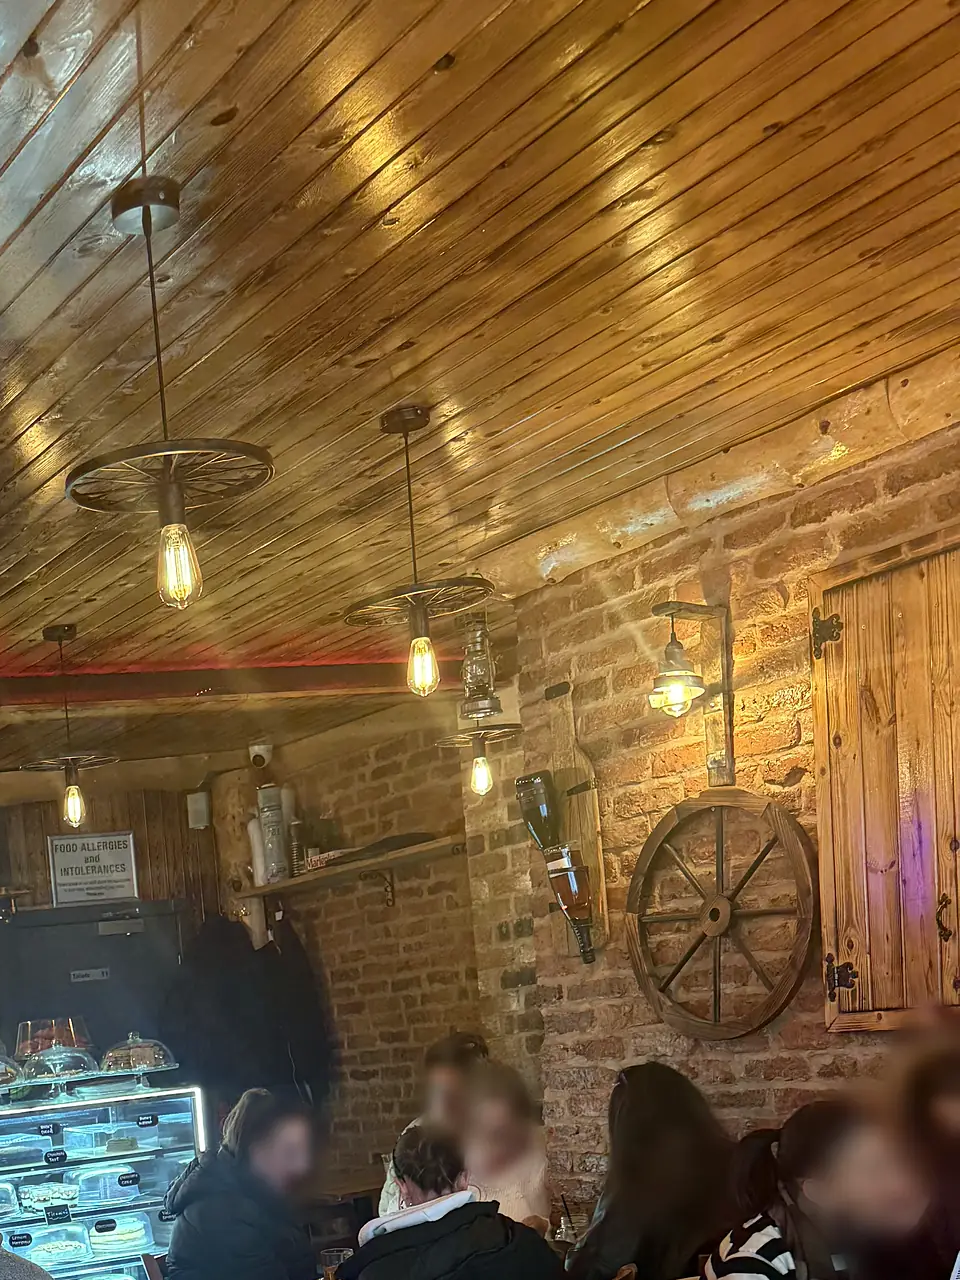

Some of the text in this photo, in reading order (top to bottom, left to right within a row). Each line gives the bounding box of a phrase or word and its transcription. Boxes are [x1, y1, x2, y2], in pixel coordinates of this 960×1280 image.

[54, 840, 128, 853] FOOD ALLERGIES
[84, 854, 100, 864] and
[60, 863, 126, 877] INTOLERANCES
